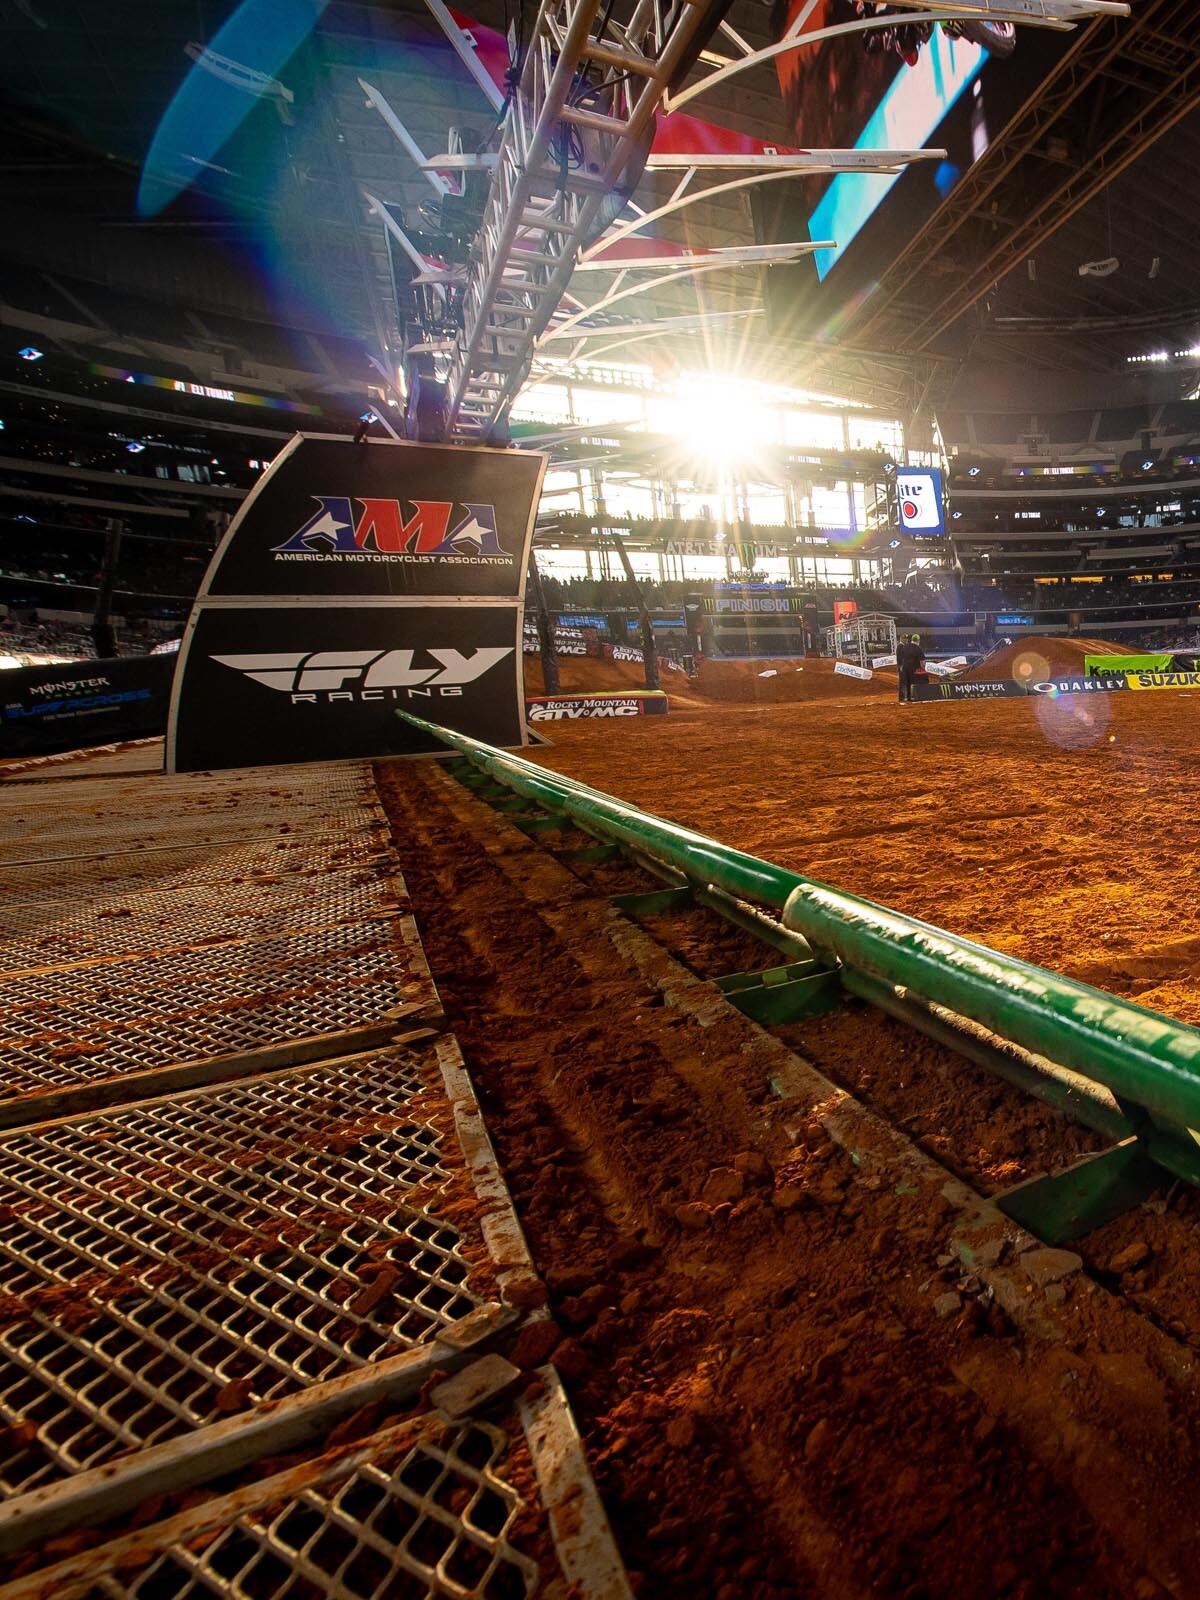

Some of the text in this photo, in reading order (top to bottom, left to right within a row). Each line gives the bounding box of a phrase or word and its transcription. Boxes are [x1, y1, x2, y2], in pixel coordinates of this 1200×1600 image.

[270, 496, 514, 556] AMA
[666, 541, 779, 558] AT&T STAUM
[274, 553, 513, 565] AMERICAN MOTORCYCLIST ASSOCIATION
[716, 599, 789, 612] FINISH
[207, 647, 516, 691] FLY
[29, 677, 111, 695] MONSTER
[955, 683, 1006, 693] MONSTER
[1060, 679, 1125, 691] OAKLEY
[291, 686, 463, 704] RACING
[547, 699, 638, 710] ROCKY MOUNTAIN
